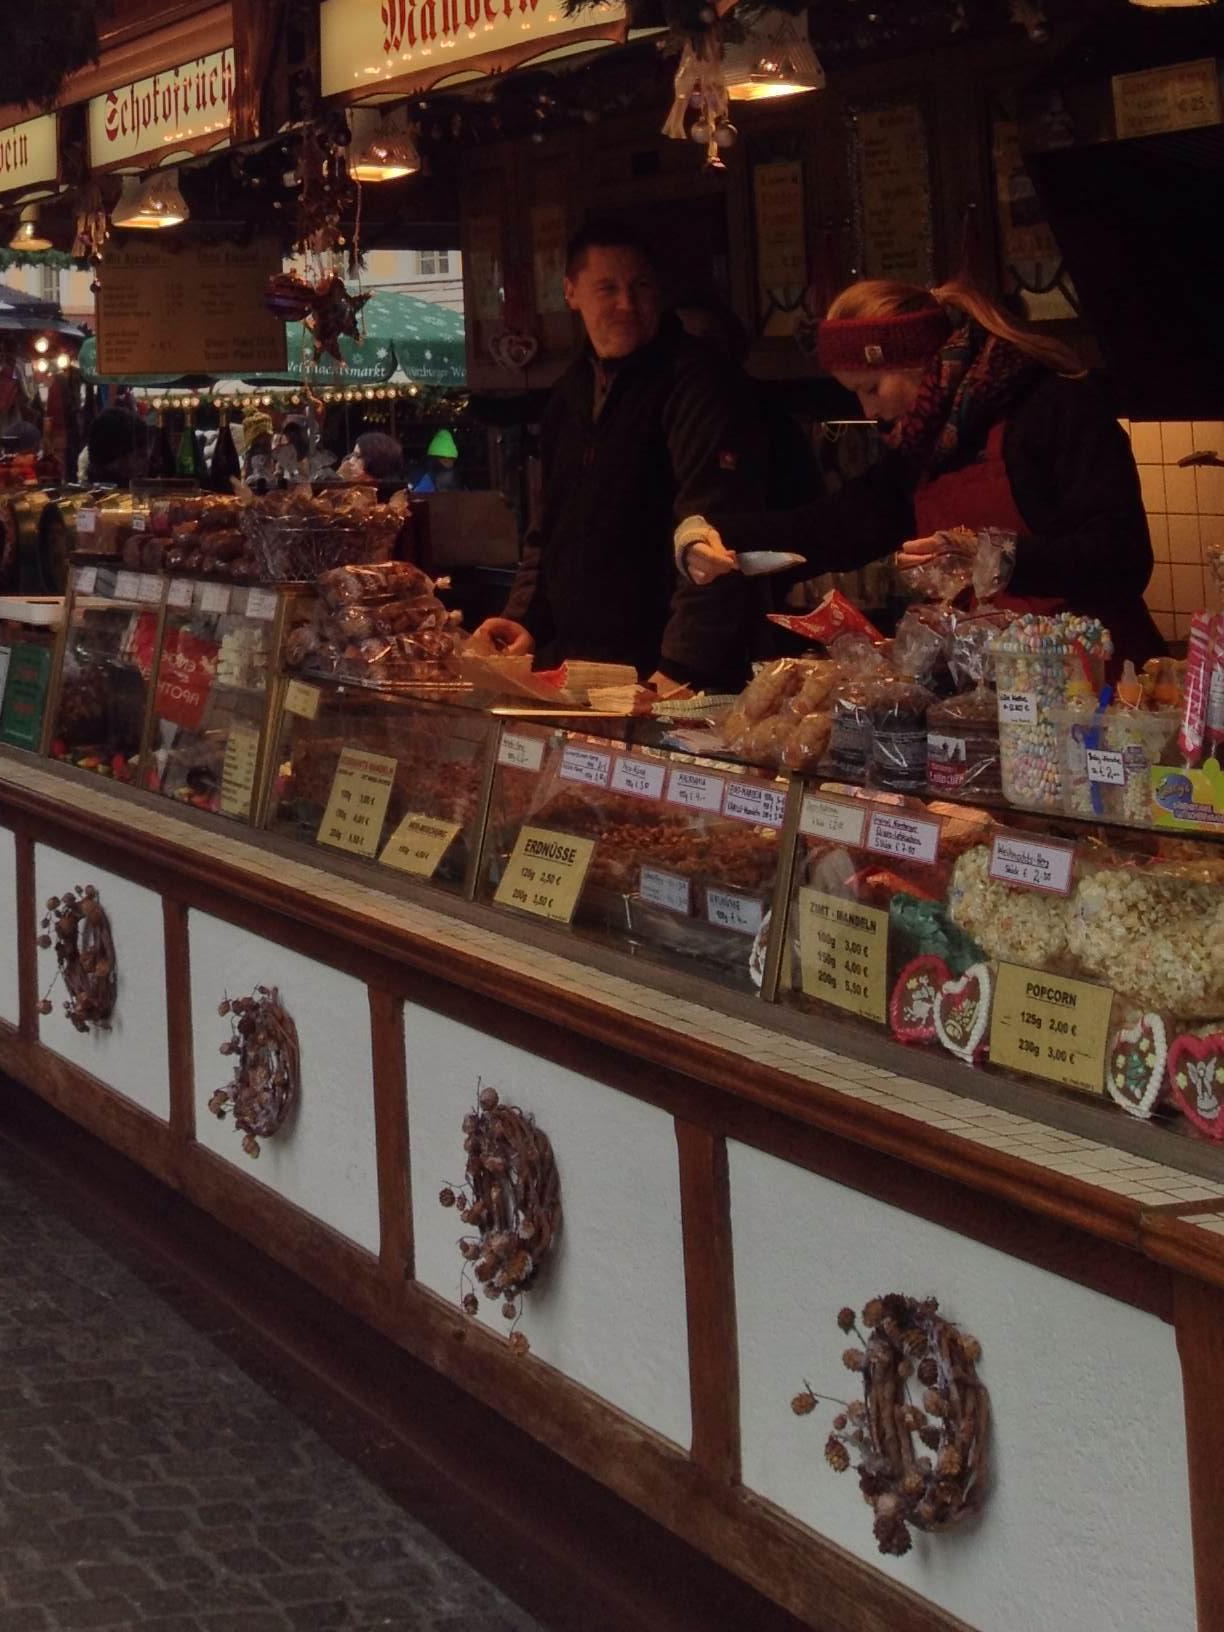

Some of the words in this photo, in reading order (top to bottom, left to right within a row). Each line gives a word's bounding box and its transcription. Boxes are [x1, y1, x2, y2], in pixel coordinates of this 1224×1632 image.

[524, 838, 577, 864] ERDNÜSSE
[836, 910, 877, 931] MANDELN
[845, 940, 862, 955] 3,00
[863, 946, 869, 958] €
[863, 966, 869, 978] €
[863, 986, 869, 999] €
[1026, 982, 1078, 1007] POPCORN
[1021, 1011, 1042, 1029] 125g
[1049, 1018, 1069, 1035] 2,00
[1071, 1024, 1078, 1037] €
[1048, 1046, 1067, 1062] 3,00
[1069, 1053, 1076, 1065] €
